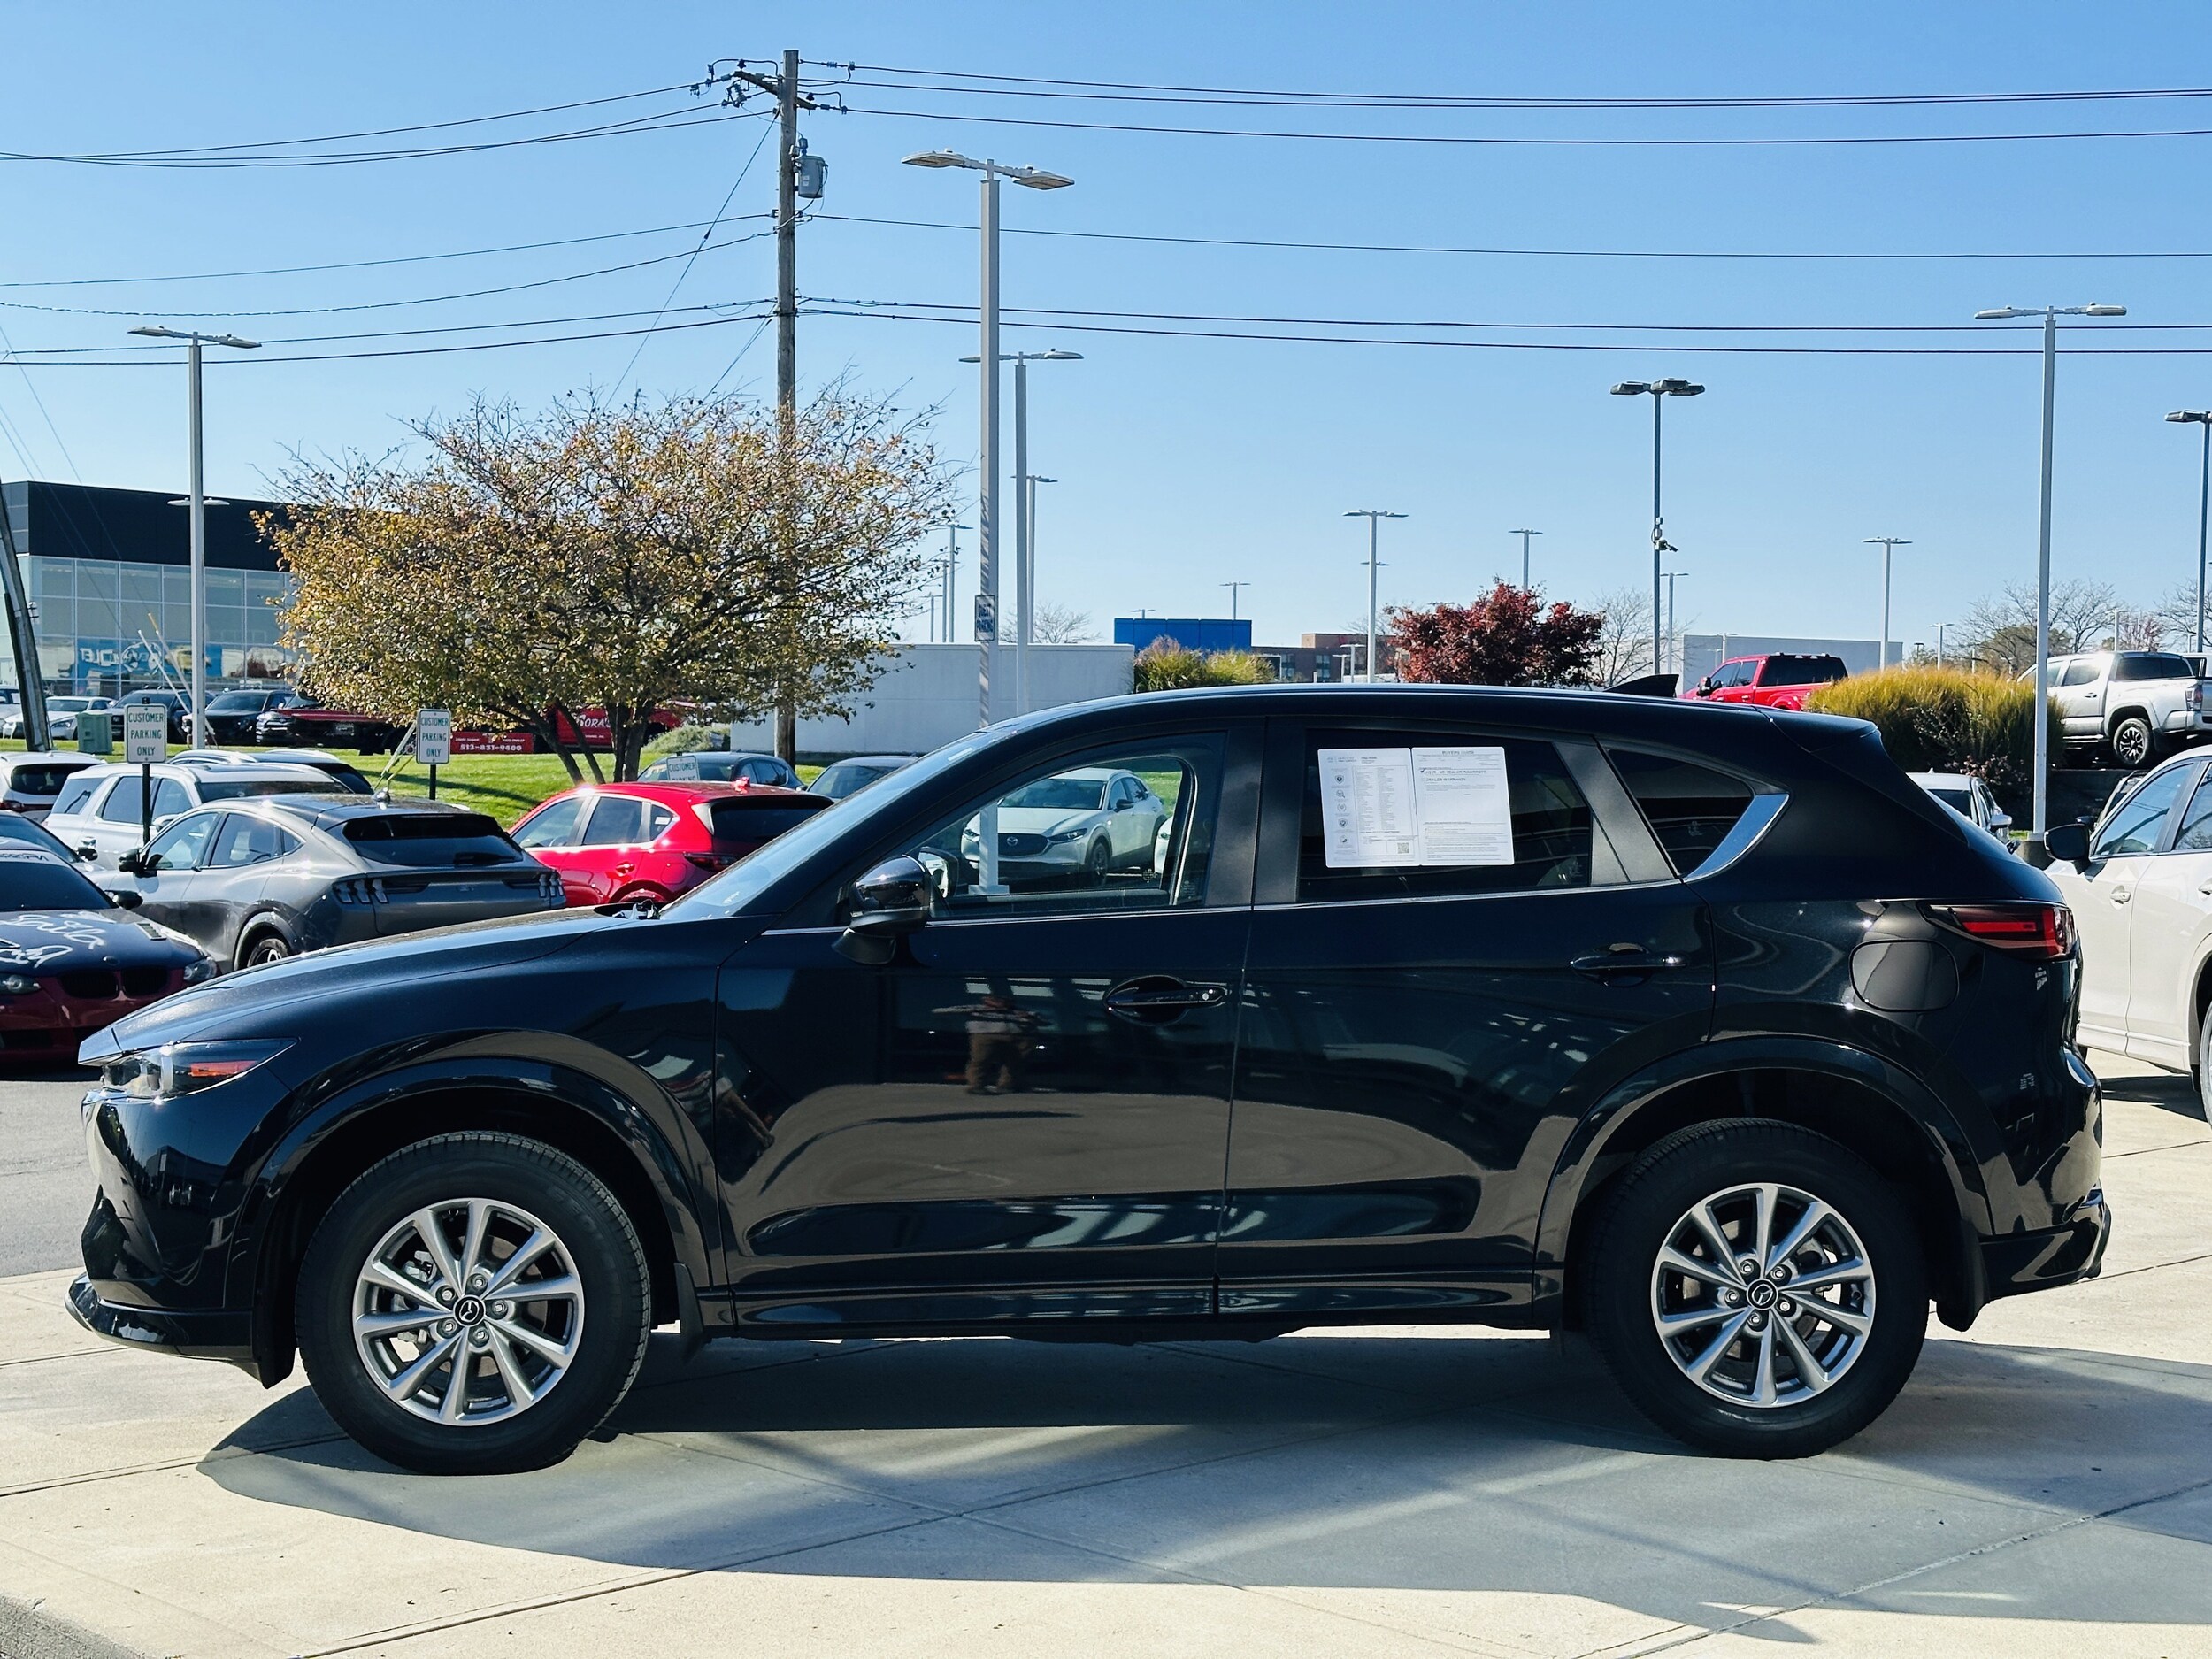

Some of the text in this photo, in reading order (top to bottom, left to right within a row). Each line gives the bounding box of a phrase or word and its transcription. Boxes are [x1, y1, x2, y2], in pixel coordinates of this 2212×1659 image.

[128, 712, 164, 723] CUSTOMER
[420, 717, 449, 726] CUSTOMER
[130, 729, 162, 740] PARKING
[421, 733, 447, 741] PARKING
[136, 746, 156, 756] ONLY
[426, 748, 442, 757] ONLY
